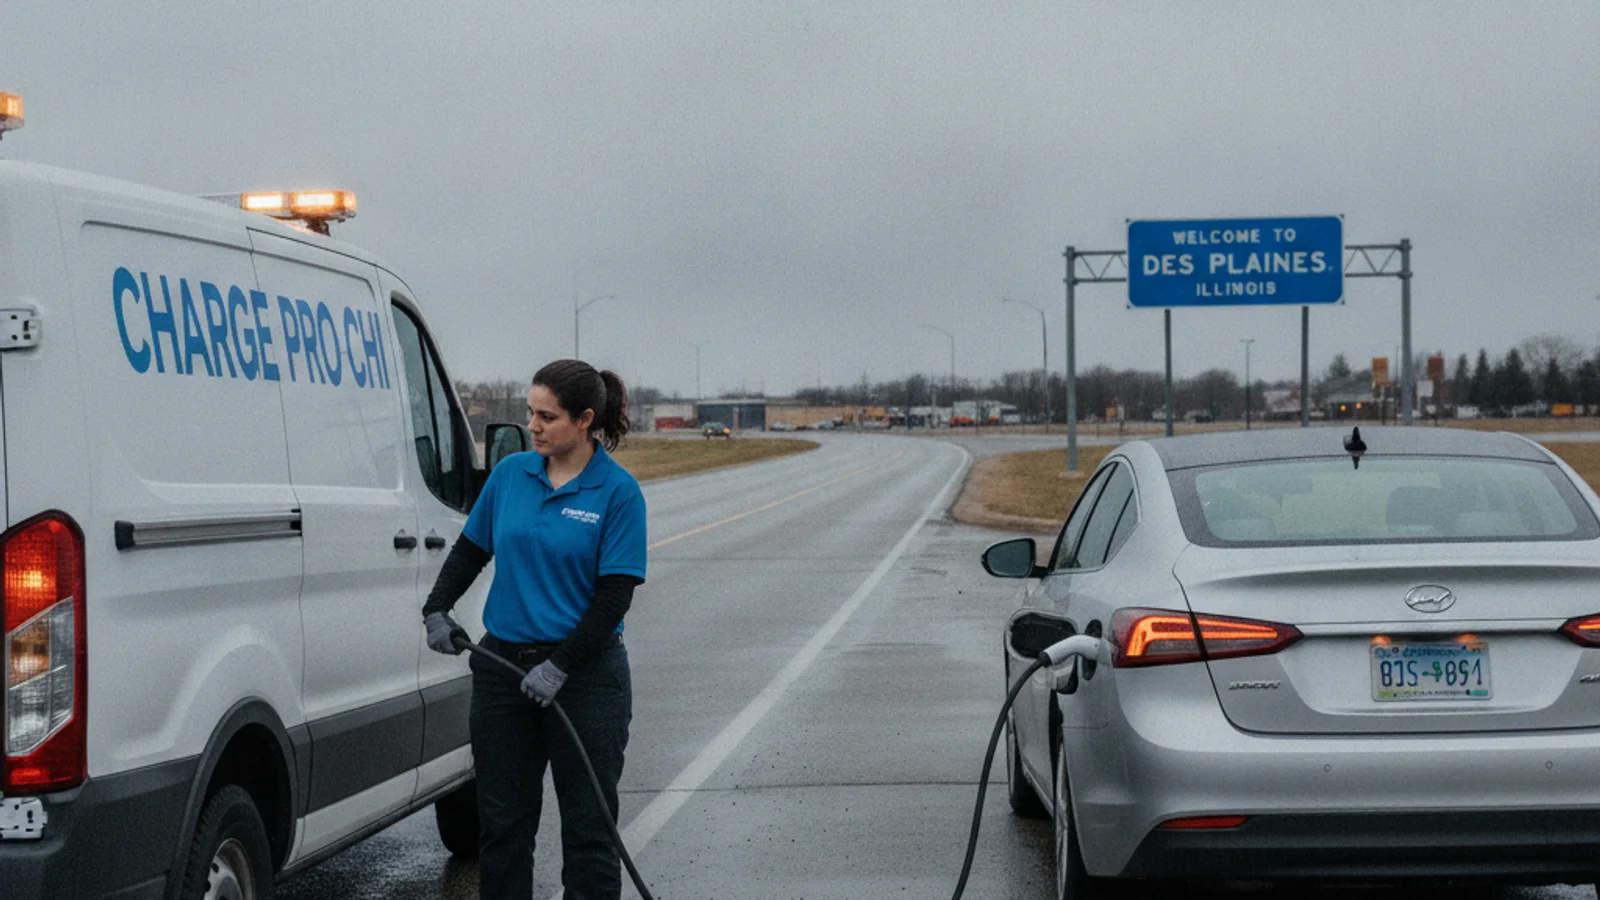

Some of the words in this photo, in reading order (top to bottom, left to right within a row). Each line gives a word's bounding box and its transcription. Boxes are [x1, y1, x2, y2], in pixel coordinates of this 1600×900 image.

[1172, 229, 1261, 245] WELCOME
[1273, 228, 1297, 242] TO
[1142, 254, 1195, 275] DES
[1196, 282, 1277, 296] ILLINOIS
[112, 266, 281, 381] CHARGE
